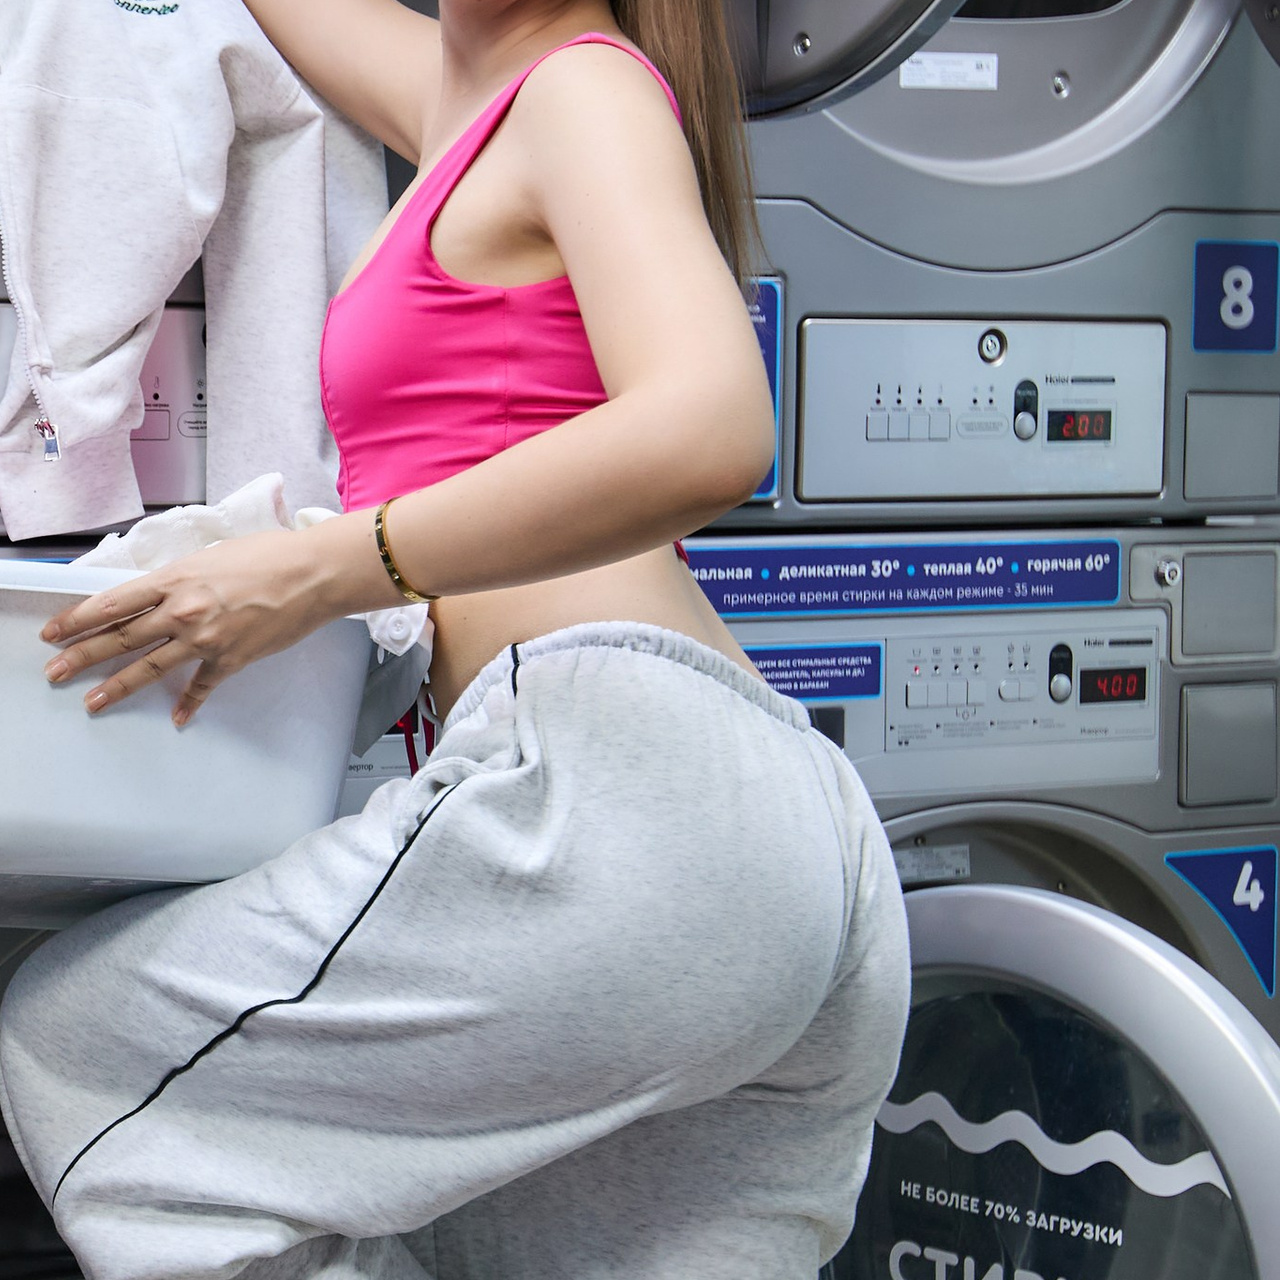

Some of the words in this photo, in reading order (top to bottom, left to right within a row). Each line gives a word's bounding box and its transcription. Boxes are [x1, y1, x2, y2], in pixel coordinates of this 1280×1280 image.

[1220, 265, 1255, 330] 8
[779, 565, 866, 580] деликатная
[924, 563, 971, 575] теплая
[1028, 558, 1081, 574] горячая
[1234, 859, 1265, 911] 4
[900, 1180, 921, 1199] НЕ
[926, 1186, 980, 1214] БОЛЕЕ
[984, 1200, 1020, 1224] 70%
[1026, 1210, 1123, 1247] ЗАГРУЗКИ
